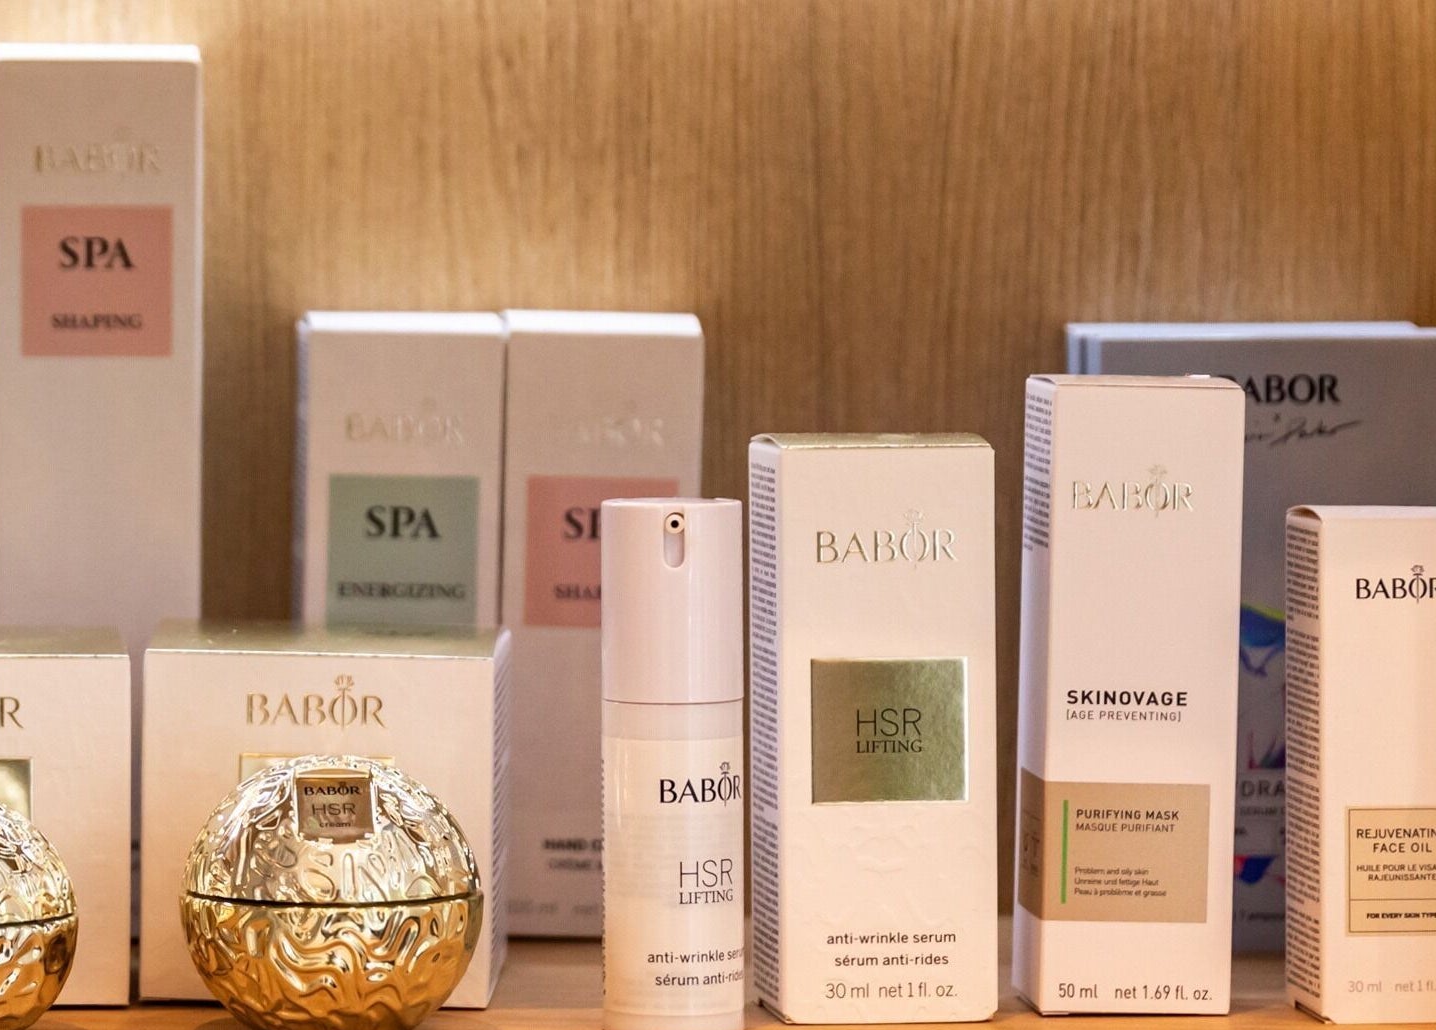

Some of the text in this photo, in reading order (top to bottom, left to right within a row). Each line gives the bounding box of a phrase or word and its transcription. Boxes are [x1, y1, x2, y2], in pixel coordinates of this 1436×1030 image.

[59, 236, 134, 271] SPA
[51, 314, 143, 330] SHAPING
[1072, 481, 1194, 511] BABOR
[364, 506, 441, 540] SPA
[816, 528, 957, 563] BABOR
[338, 582, 466, 600] ENERGIZING
[1067, 690, 1188, 706] SKINOVAGE
[246, 692, 387, 730] BABOR
[1066, 709, 1182, 723] [AGE PREVENTING]
[856, 708, 922, 737] HSR
[856, 740, 923, 754] LIFTING
[304, 786, 362, 796] BABOR
[659, 776, 741, 803] BABOR
[312, 803, 356, 816] HSR
[1076, 809, 1179, 821] PURIFYING MASK
[1075, 823, 1176, 833] MASQUE PURIFIANT
[1373, 842, 1433, 853] FACE OIL
[679, 859, 733, 888] HSR
[1074, 866, 1104, 875] Problem
[1106, 867, 1120, 875] and
[1356, 864, 1381, 872] HUILE
[1382, 864, 1405, 872] POUR
[1407, 864, 1417, 872] LE
[679, 889, 734, 905] LIFTING
[826, 932, 956, 945] anti-wrinkle serum
[834, 953, 949, 967] sérum anti-rides
[825, 982, 957, 999] 30 ml net 1 fl. oz.
[1058, 983, 1212, 1001] 50 ml net 1.69 fl. oz.
[1348, 981, 1364, 993] 30
[1366, 980, 1382, 992] ml
[1394, 981, 1414, 992] net
